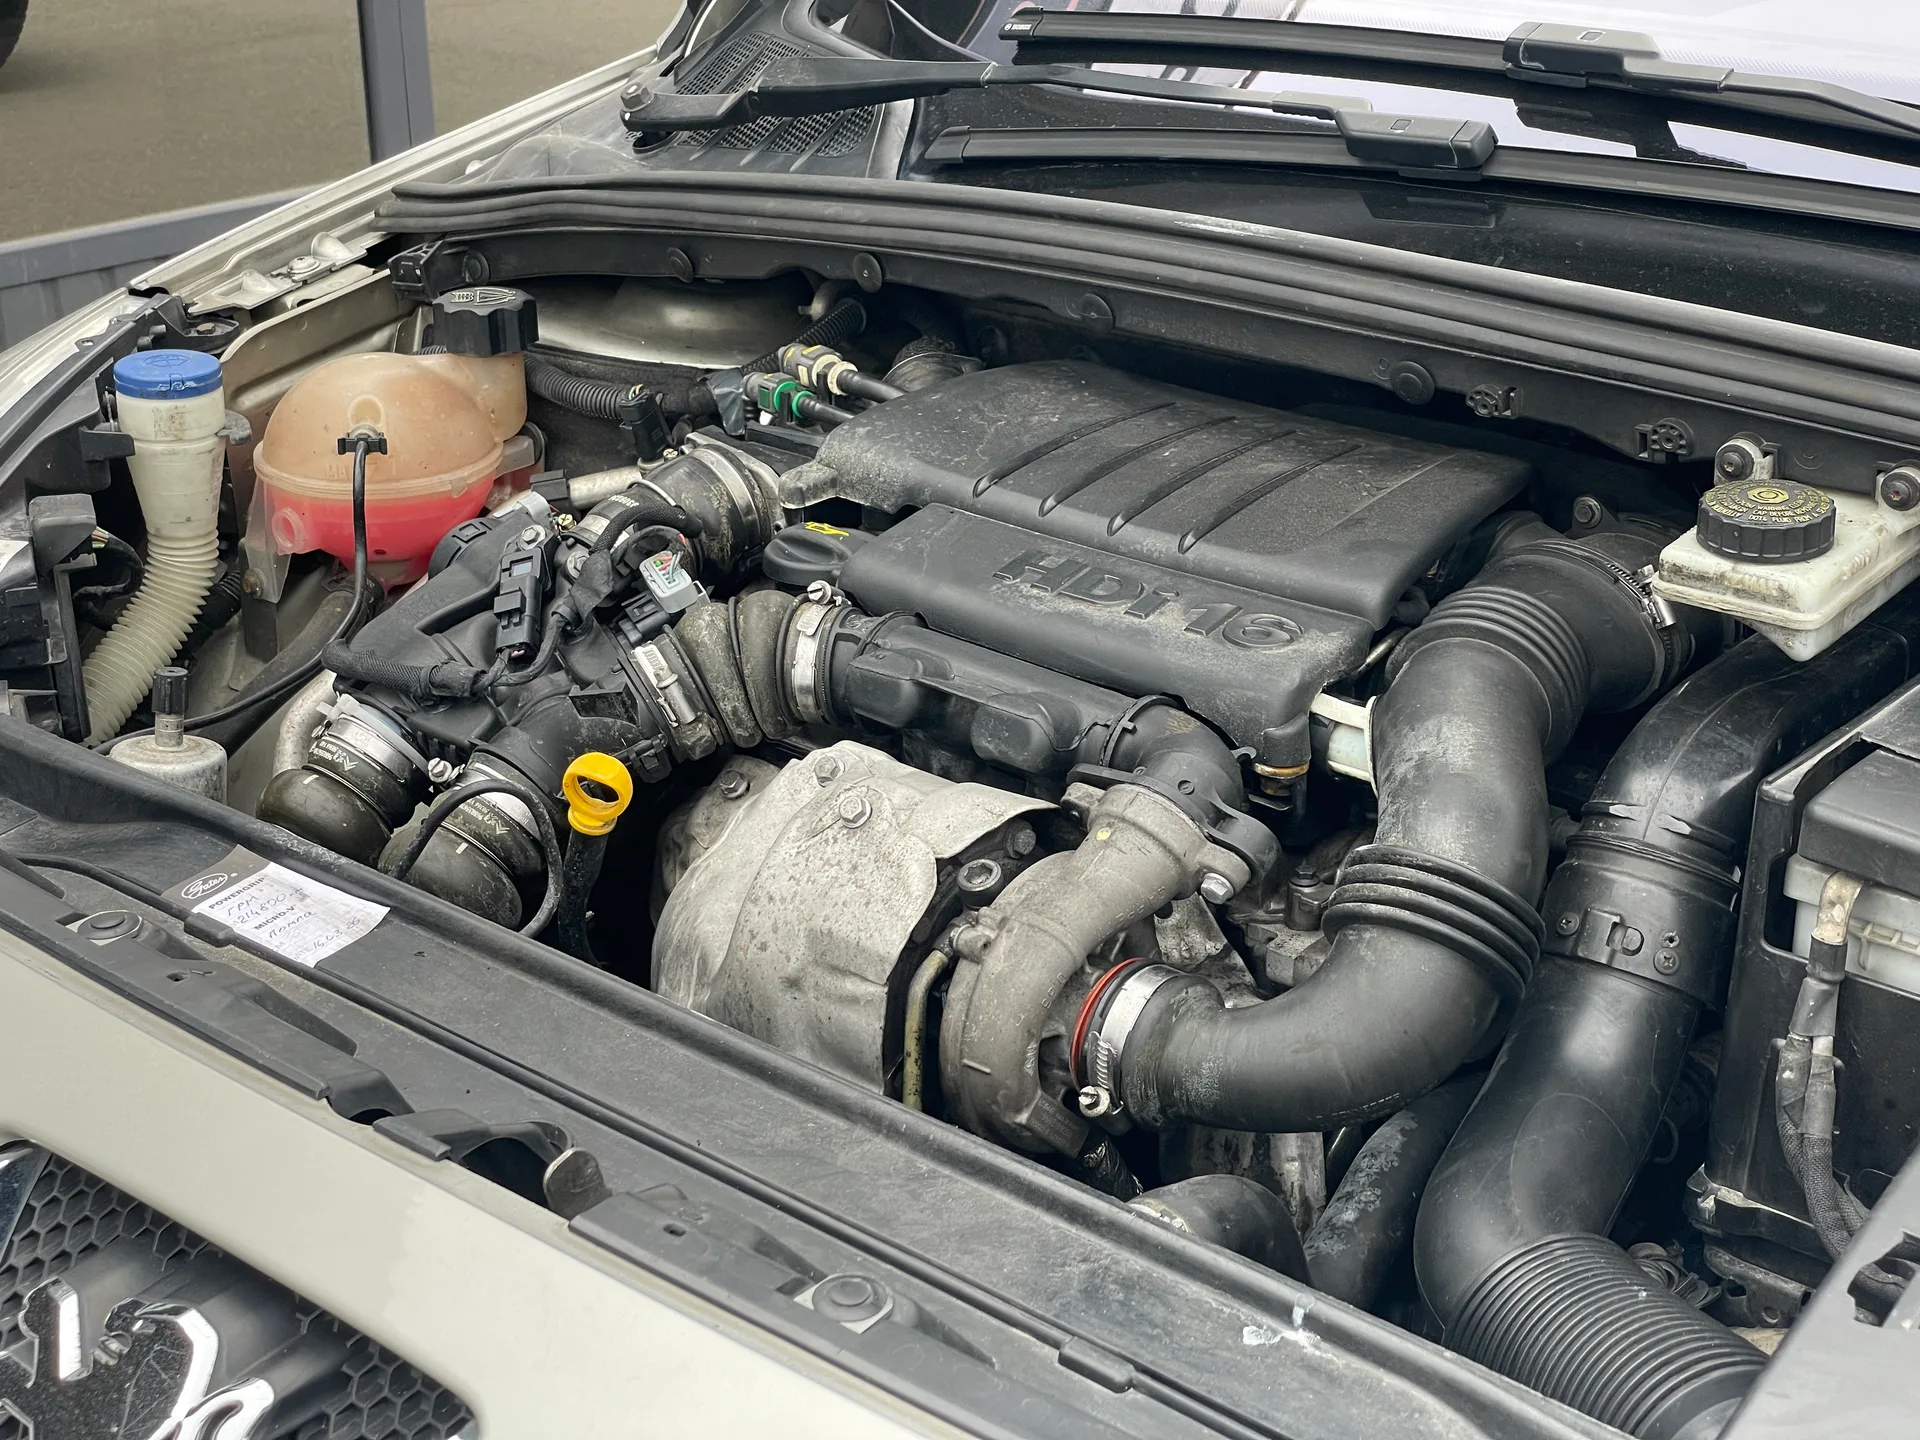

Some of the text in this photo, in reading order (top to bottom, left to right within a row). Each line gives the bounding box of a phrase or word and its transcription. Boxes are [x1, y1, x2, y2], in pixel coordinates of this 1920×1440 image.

[1183, 602, 1304, 649] 16
[188, 875, 226, 898] Gates
[208, 877, 266, 910] POWERGRIP
[254, 905, 295, 931] MICRO-V
